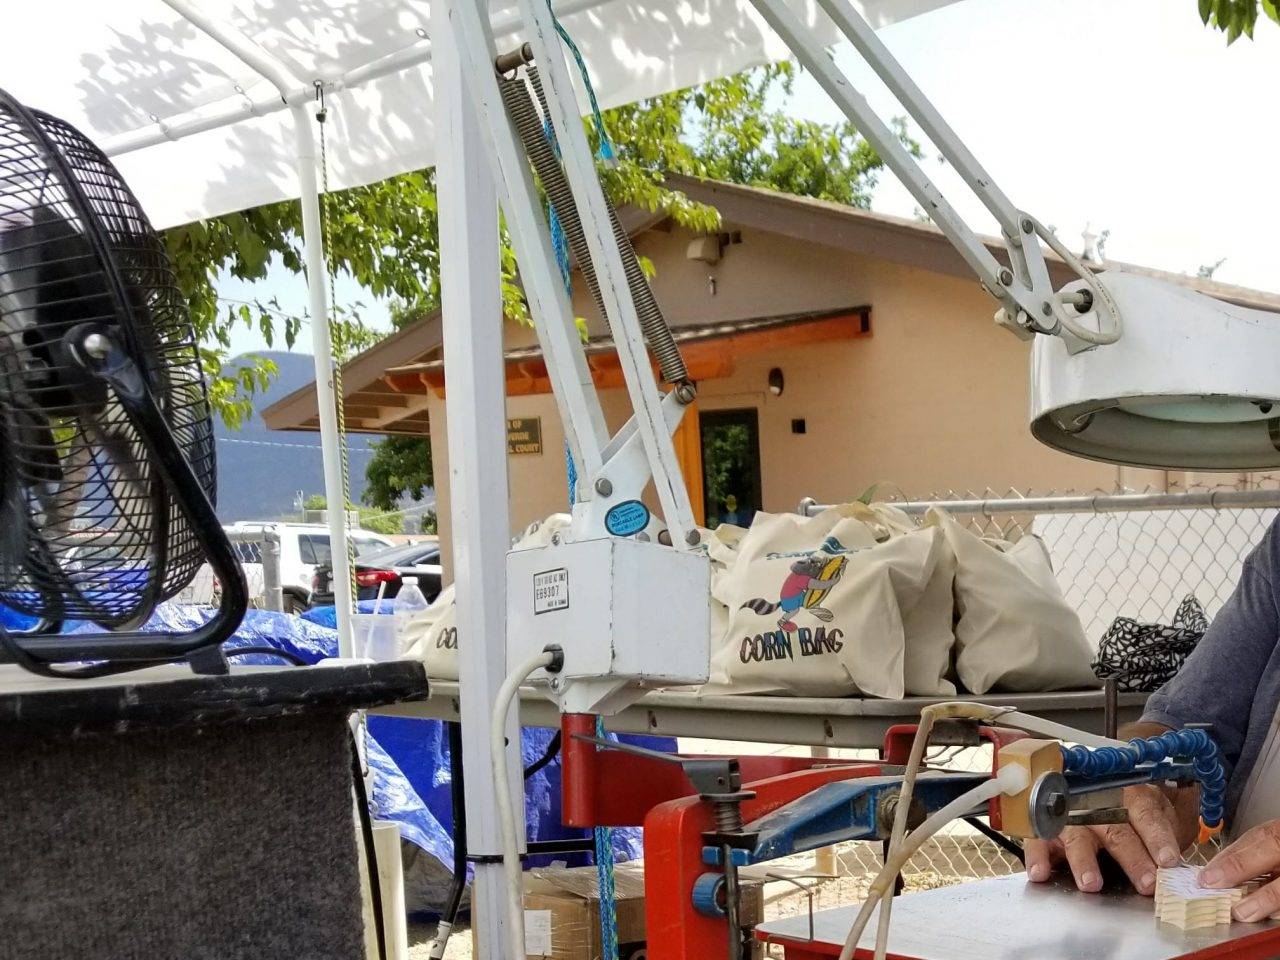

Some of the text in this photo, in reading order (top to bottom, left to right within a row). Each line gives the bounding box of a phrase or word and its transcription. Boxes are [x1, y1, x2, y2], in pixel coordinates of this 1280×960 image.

[436, 626, 459, 649] CO
[740, 625, 844, 663] CORN BAG
